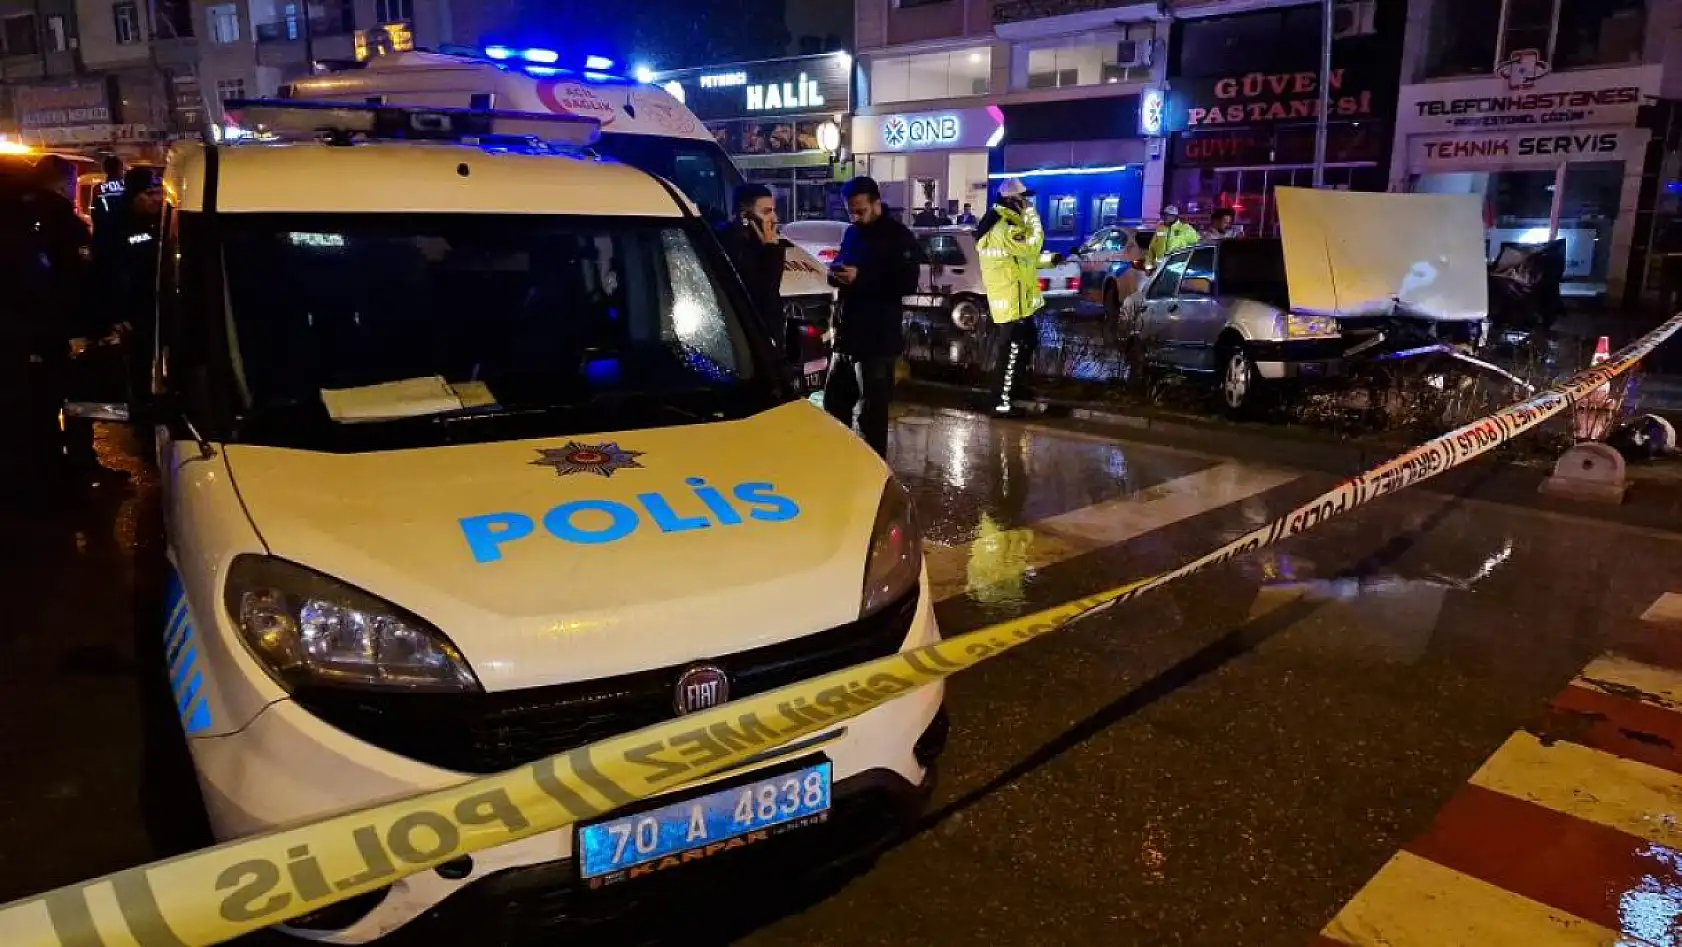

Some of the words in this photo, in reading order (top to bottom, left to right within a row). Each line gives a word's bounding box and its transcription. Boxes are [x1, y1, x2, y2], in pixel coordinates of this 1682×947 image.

[746, 72, 824, 110] HALİL
[909, 118, 957, 141] QNB
[1518, 133, 1617, 155] SERVİS
[458, 476, 800, 564] POLİS
[687, 681, 718, 711] FIAT
[608, 816, 659, 864] 70
[686, 804, 708, 843] A
[733, 770, 823, 826] 4838
